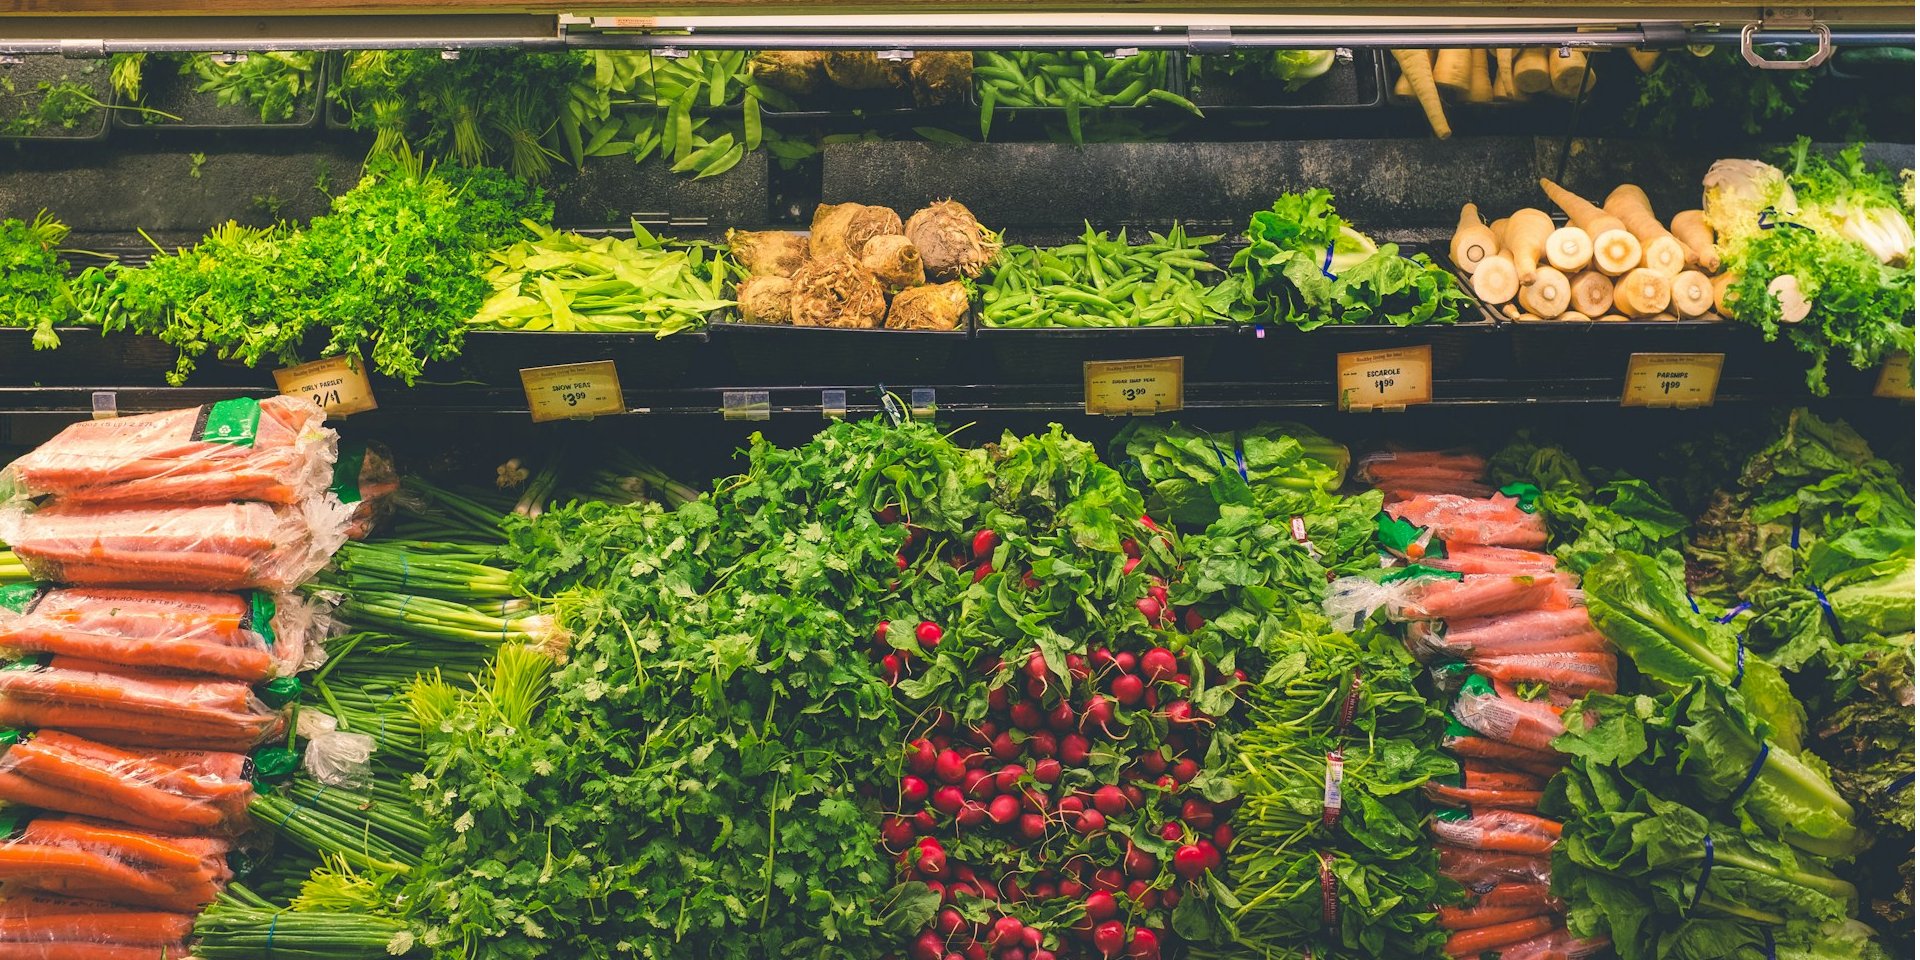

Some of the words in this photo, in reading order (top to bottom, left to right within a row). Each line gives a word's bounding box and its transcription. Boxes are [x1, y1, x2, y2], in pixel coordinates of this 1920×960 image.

[1366, 368, 1401, 378] ESCAROLE
[301, 383, 318, 393] CURLY
[319, 377, 344, 389] PARSLEY
[552, 383, 572, 392] SNOW
[573, 381, 591, 390] PEAS
